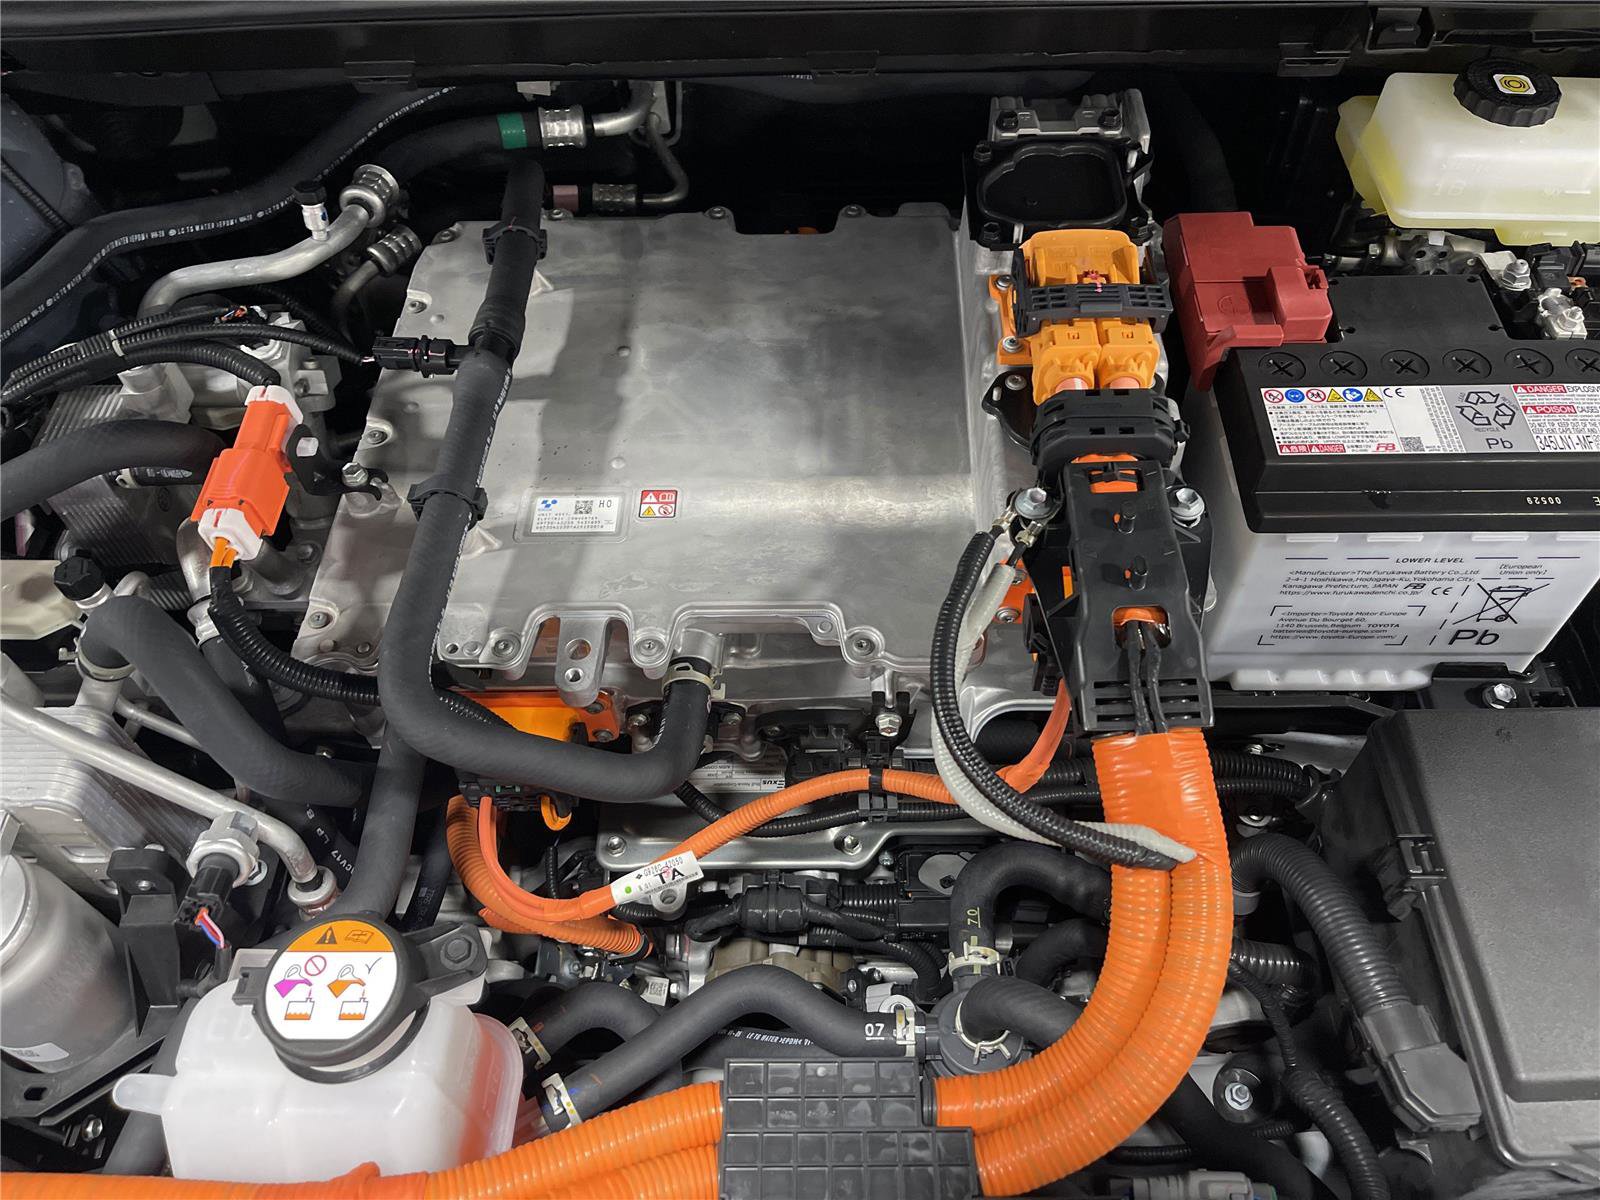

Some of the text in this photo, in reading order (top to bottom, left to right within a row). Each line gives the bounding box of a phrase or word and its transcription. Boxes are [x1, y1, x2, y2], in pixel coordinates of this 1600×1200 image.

[1527, 385, 1566, 393] DANGER
[1536, 405, 1575, 414] POISON
[1486, 438, 1513, 449] Pb
[1448, 629, 1501, 646] Pb
[865, 1023, 885, 1036] 07
